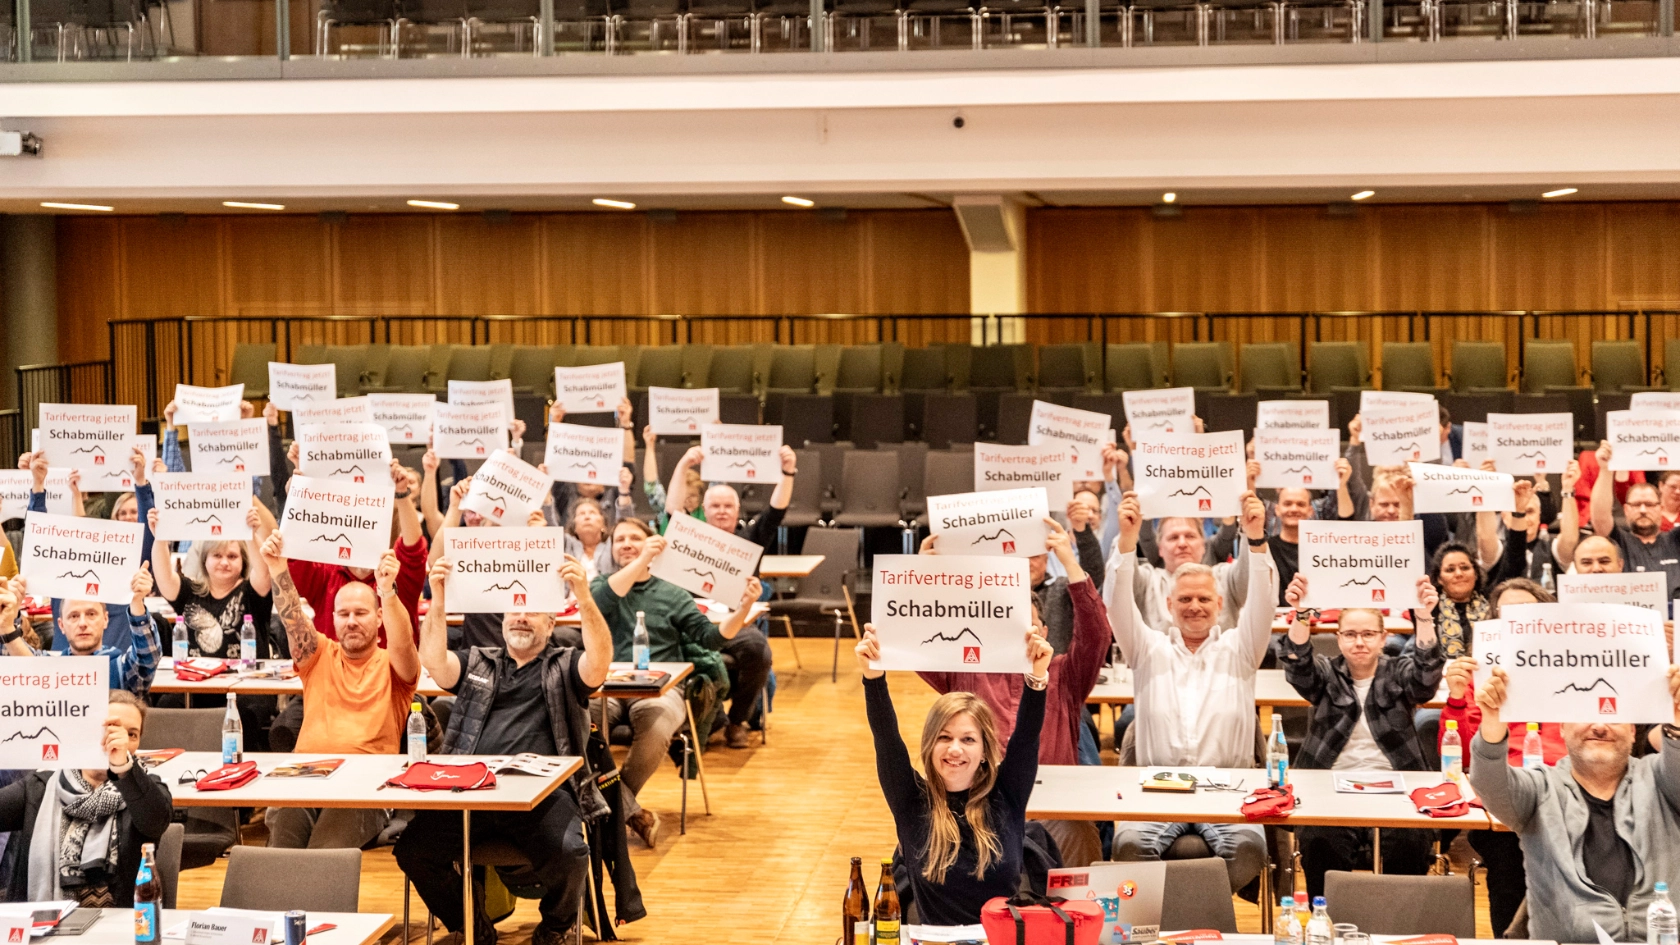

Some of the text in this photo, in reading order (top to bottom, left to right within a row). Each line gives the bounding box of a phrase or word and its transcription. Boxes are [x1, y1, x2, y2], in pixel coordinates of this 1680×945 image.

[276, 380, 327, 392] Schabmüller
[564, 382, 617, 392] Schabmüller
[373, 411, 426, 421] Schabmüller
[656, 405, 710, 414] Schabmüller
[1132, 408, 1186, 418] Schabmüller
[44, 412, 130, 425] Tarifvertrag jetzt!
[49, 429, 125, 441] Schabmüller
[438, 425, 499, 435] Schabmüller
[1036, 425, 1098, 445] Schabmüller
[1372, 425, 1432, 441] Schabmüller
[303, 432, 359, 443] Tarifvertrag
[1497, 437, 1563, 447] Schabmüller
[1617, 433, 1680, 443] Schabmülle
[198, 441, 259, 452] Schabmüller
[553, 445, 613, 460] Schabmüller
[709, 446, 772, 457] Schabmüller
[1142, 442, 1239, 458] Tarifvertrag jetzt!
[307, 449, 383, 462] Schabmüller
[980, 452, 1066, 465] Tarifvertrag jetzt!
[1264, 451, 1330, 462] Schabmüller
[985, 470, 1062, 482] Schabmüller
[1145, 464, 1234, 480] Schabmüller
[160, 480, 246, 492] Tarifvertrag jetzt!
[473, 471, 532, 503] chabmüller
[0, 491, 63, 500] Schabller
[291, 486, 386, 508] Tarifvertrag jetzt!
[164, 498, 241, 511] Schabmüller
[287, 507, 378, 530] Schabmüller
[942, 508, 1035, 530] Schabmüller
[30, 523, 135, 545] Tarifvertrag jetzt!
[1305, 531, 1416, 547] Tarifvertrag jetzt!
[450, 538, 556, 552] Tarifvertrag jetzt!
[674, 521, 753, 562] Tarifvertrag jetzt!
[32, 545, 127, 567] Schabmüller
[669, 539, 741, 577] Schabmüller
[1312, 555, 1411, 570] Schabmüller
[457, 559, 551, 574] Schabmüller
[880, 570, 1021, 590] Tarifvertrag jetzt!
[1564, 582, 1660, 595] Tarifvertrag jetzt!
[886, 599, 1014, 620] Schabmüller
[1508, 619, 1607, 639] Tarifvertrag
[1611, 619, 1656, 637] jetzt!
[1515, 649, 1651, 669] Schabmüller
[0, 671, 98, 690] ertrag jetzt!
[1, 700, 90, 718] abmüller
[1049, 873, 1090, 888] FREI
[191, 922, 227, 932] Florian Bauer
